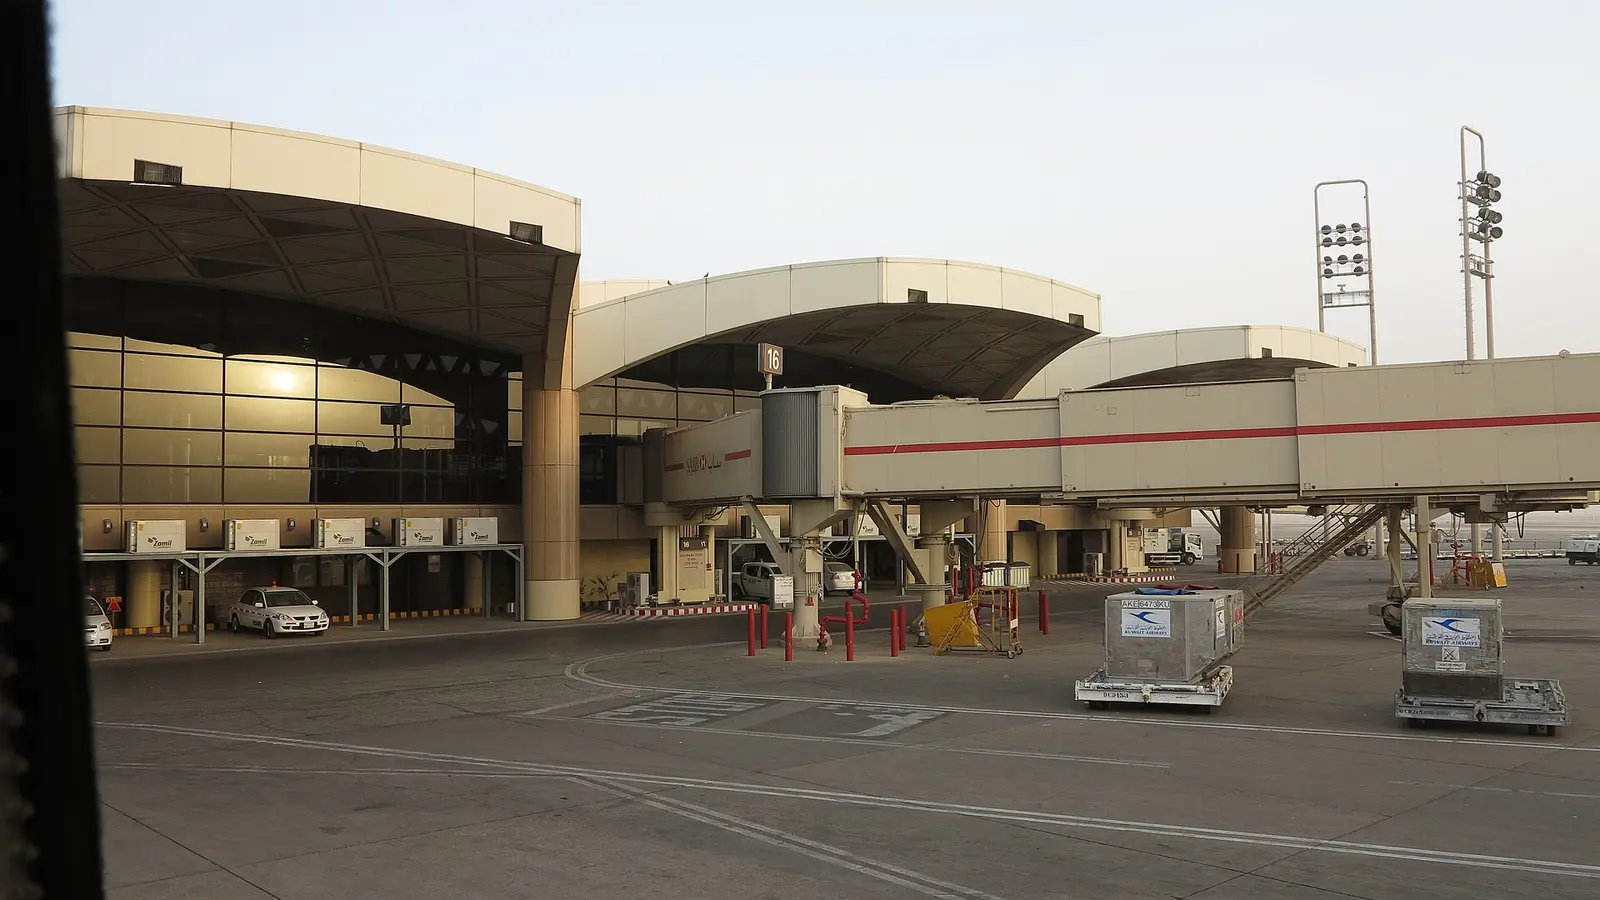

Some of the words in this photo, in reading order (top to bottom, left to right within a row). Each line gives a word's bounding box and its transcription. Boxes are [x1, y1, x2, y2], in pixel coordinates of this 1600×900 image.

[767, 348, 780, 370] 16
[1122, 600, 1138, 608] AKE
[1159, 601, 1170, 609] KU
